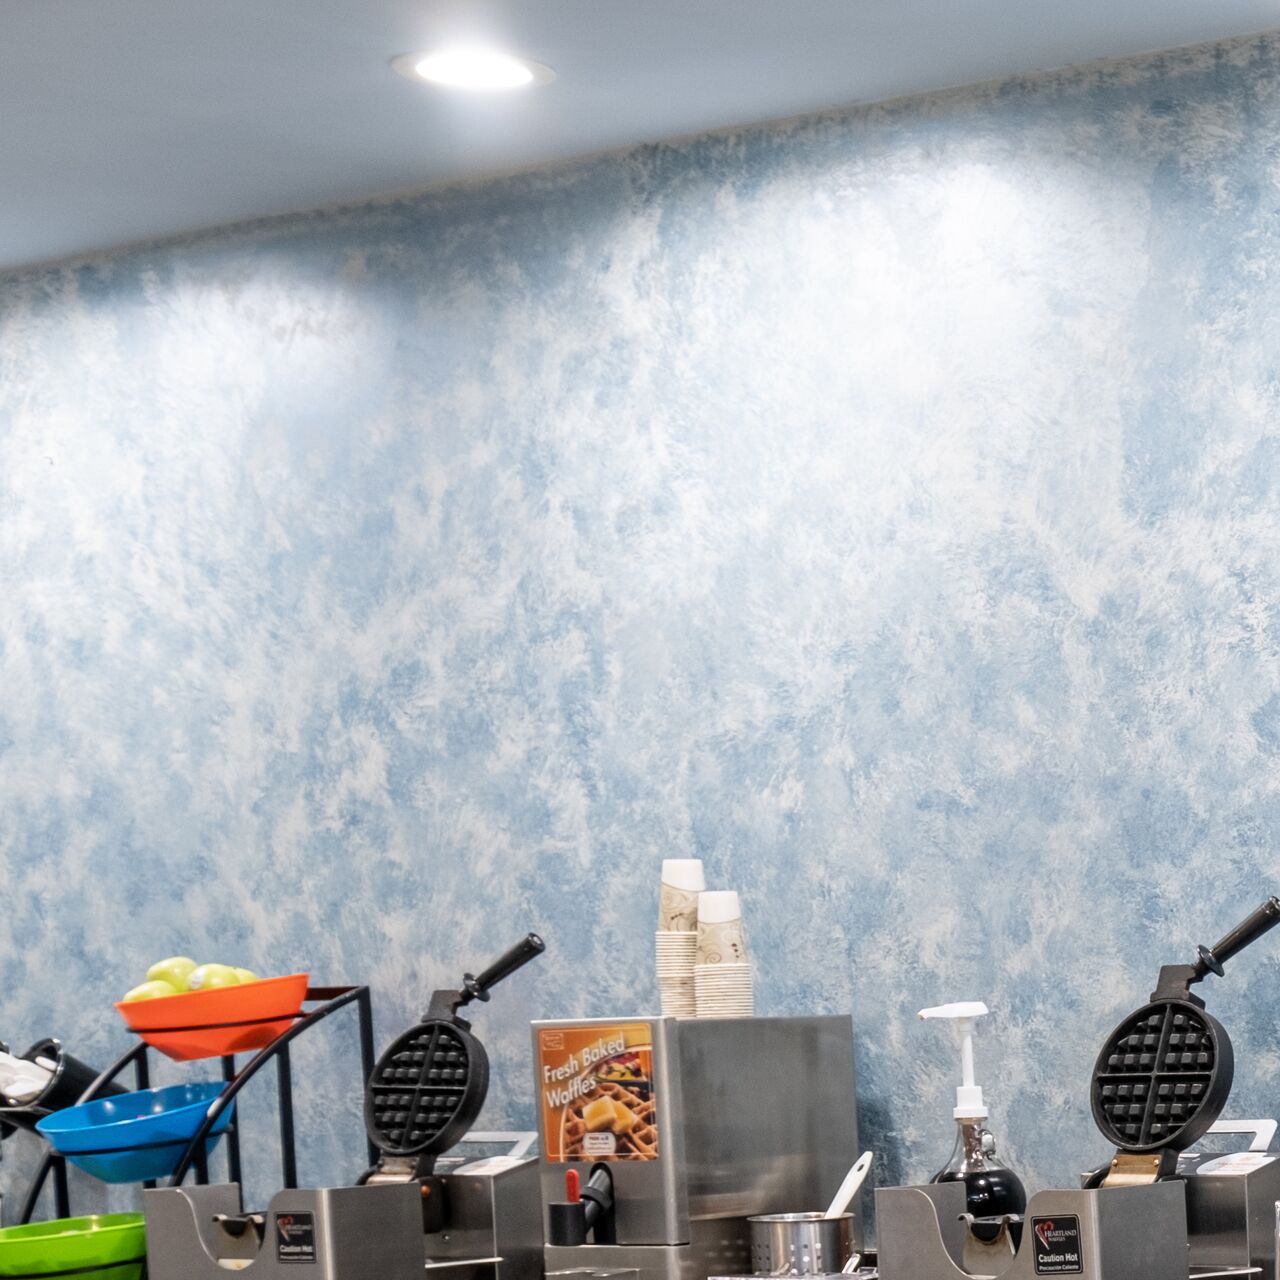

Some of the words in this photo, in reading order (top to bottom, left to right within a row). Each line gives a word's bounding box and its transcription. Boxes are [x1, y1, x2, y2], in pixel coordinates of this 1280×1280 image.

[543, 1053, 580, 1084] Fresh
[581, 1031, 625, 1067] Baked
[546, 1074, 598, 1109] Waffles
[1038, 1254, 1064, 1262] Caution
[1065, 1253, 1078, 1262] Hot
